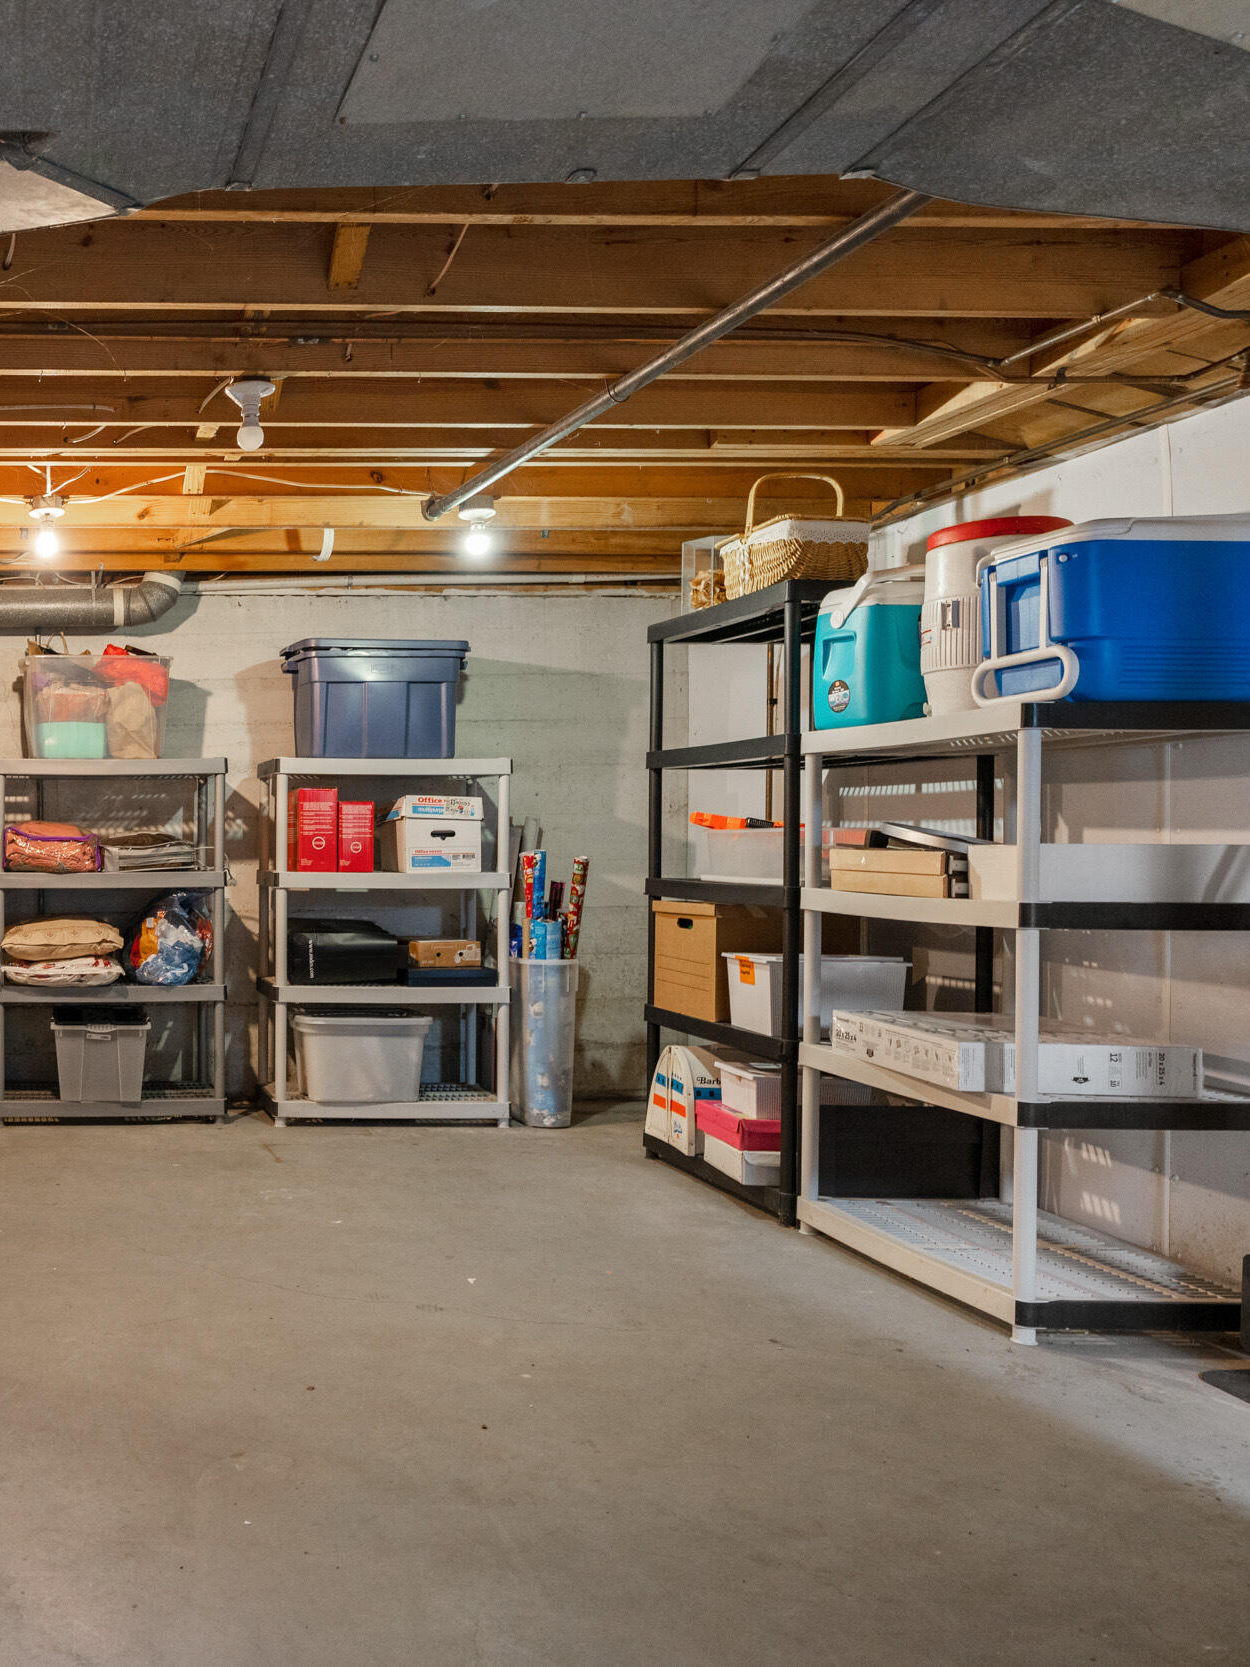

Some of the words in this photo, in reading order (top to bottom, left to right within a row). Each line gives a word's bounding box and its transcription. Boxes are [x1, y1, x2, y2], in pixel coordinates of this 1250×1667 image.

[1109, 1053, 1118, 1062] 12
[1158, 1053, 1165, 1061] 20
[1158, 1067, 1165, 1075] 25
